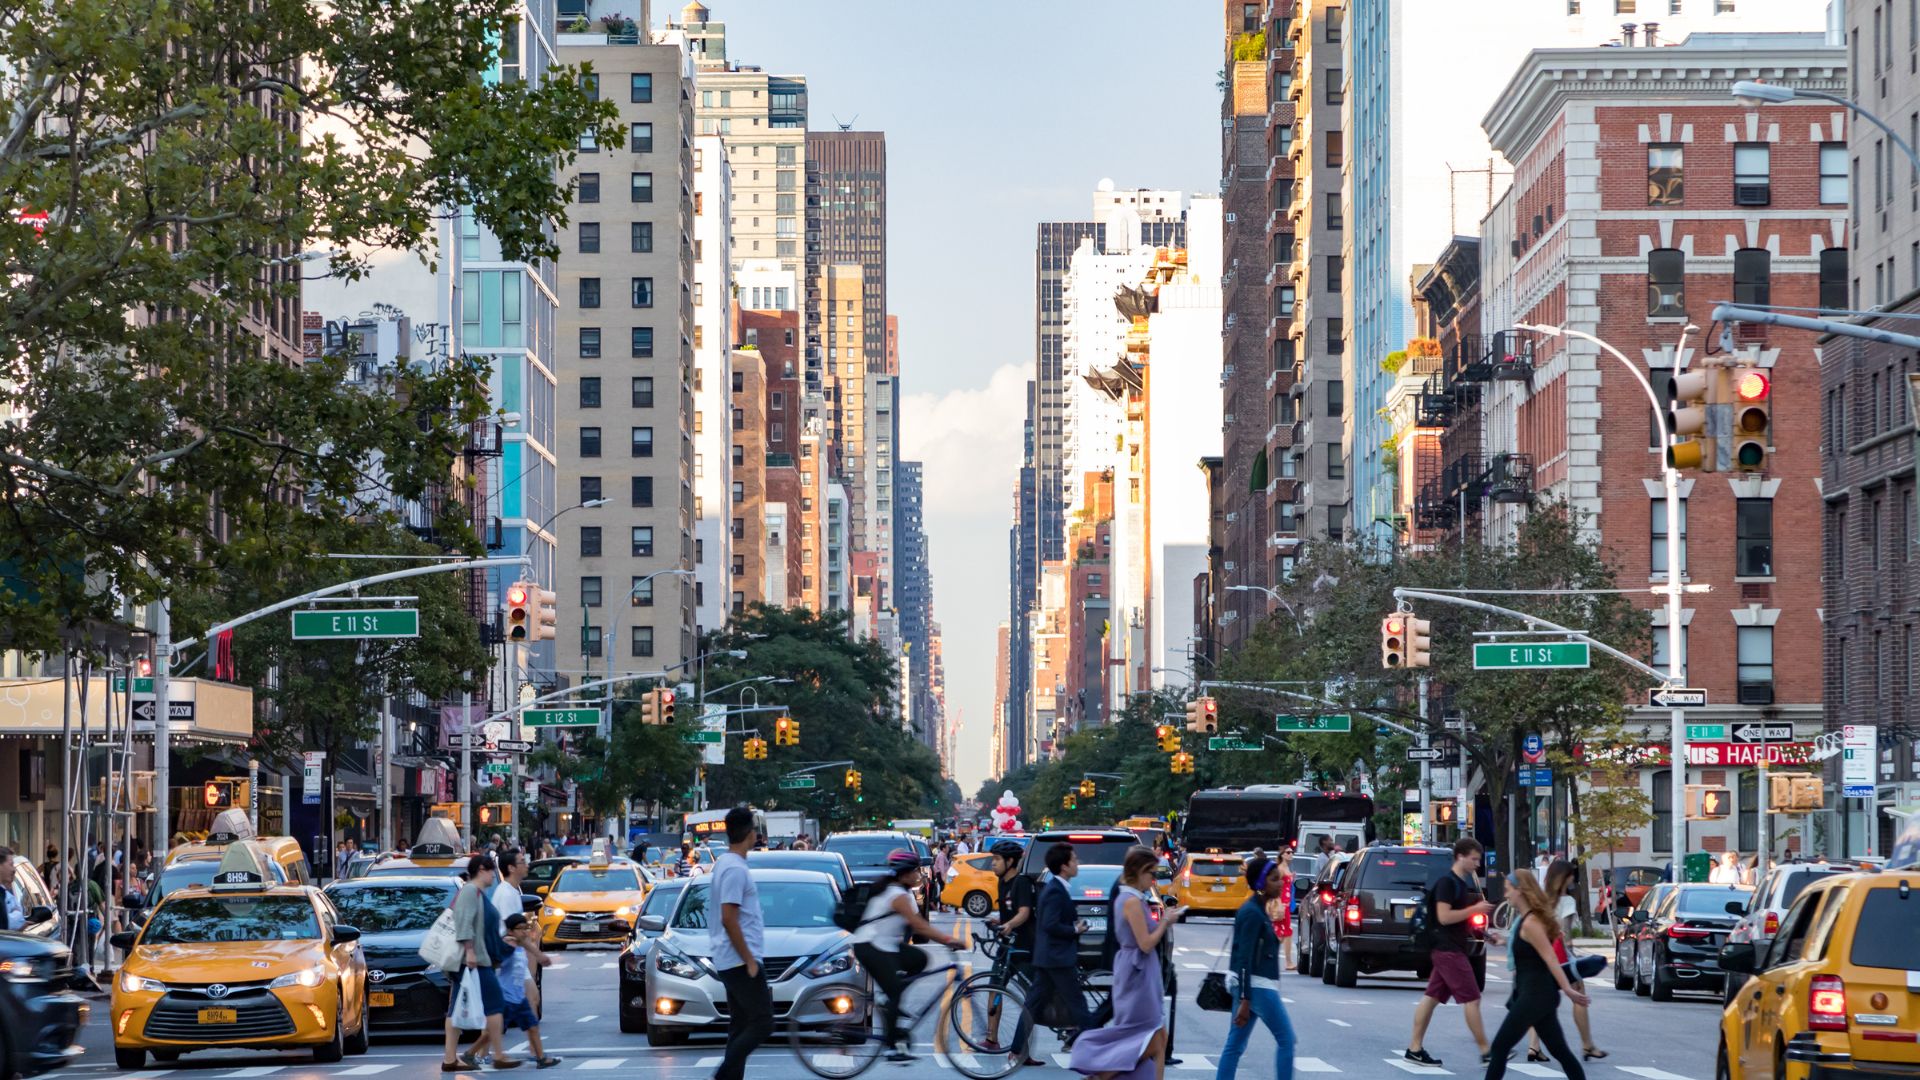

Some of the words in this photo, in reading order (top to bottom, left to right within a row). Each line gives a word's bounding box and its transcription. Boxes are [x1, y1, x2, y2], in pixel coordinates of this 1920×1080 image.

[332, 616, 341, 632] E
[347, 616, 356, 632] 11
[362, 615, 378, 632] St
[1510, 648, 1519, 663] E
[1524, 648, 1533, 663] 11
[1538, 648, 1552, 663] St
[1660, 694, 1676, 702] ONE
[1684, 694, 1700, 702] WAY
[143, 705, 155, 716] ON
[169, 705, 188, 716] WAY
[545, 713, 552, 723] E
[555, 713, 564, 723] 12
[567, 712, 577, 723] St
[1318, 718, 1328, 728] St
[1691, 727, 1697, 737] E
[1702, 727, 1708, 737] 11
[1743, 729, 1760, 738] ONE
[1768, 729, 1787, 737] WAY
[425, 844, 440, 854] 7C47
[226, 872, 248, 883] 8H94
